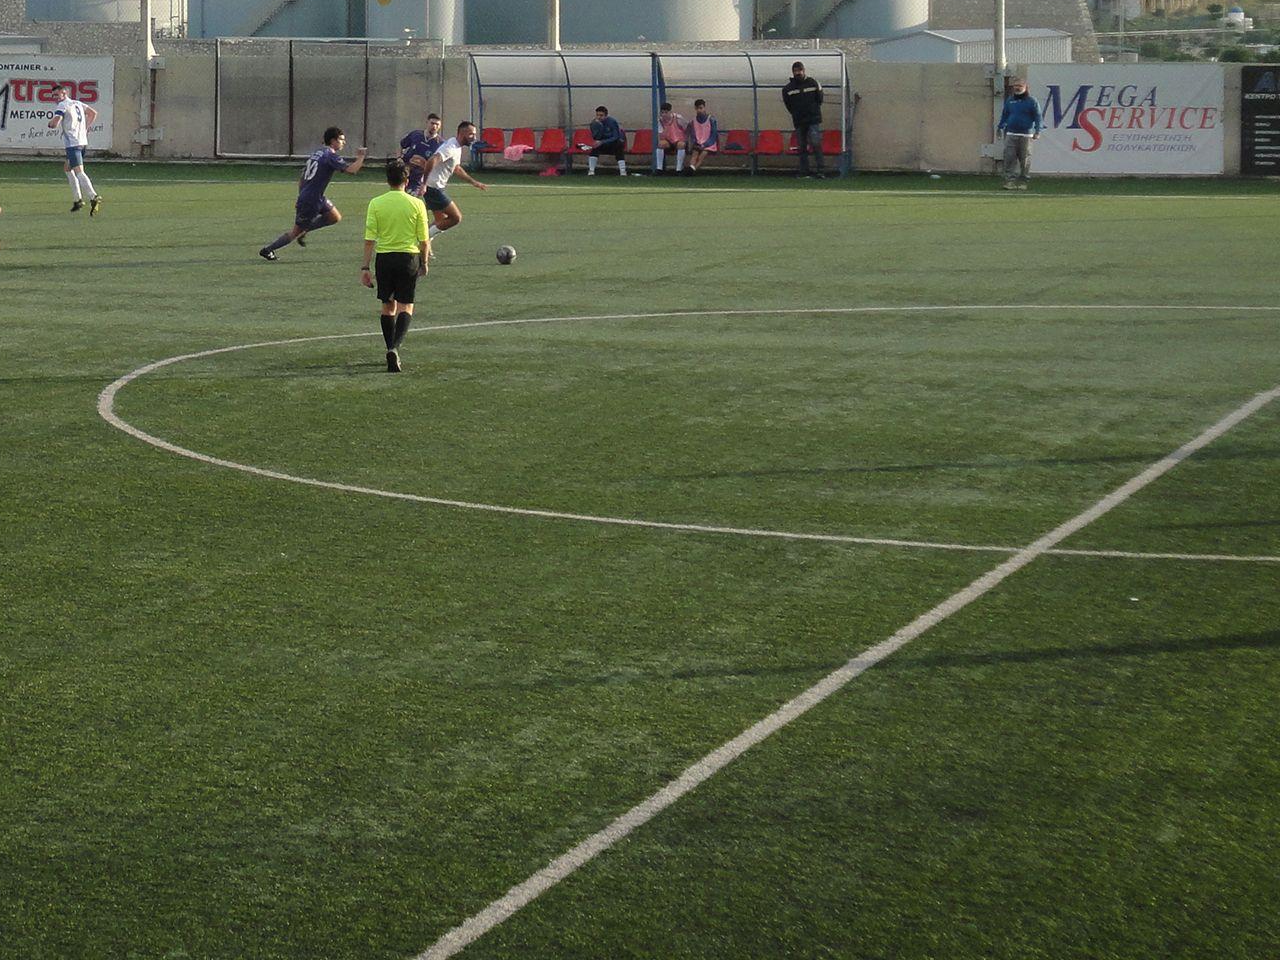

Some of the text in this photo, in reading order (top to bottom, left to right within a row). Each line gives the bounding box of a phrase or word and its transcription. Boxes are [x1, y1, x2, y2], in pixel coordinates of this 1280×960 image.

[9, 109, 54, 120] ΜΕΤΑΦΟ
[74, 105, 83, 123] 9
[1042, 84, 1158, 130] MEGA
[1071, 106, 1218, 152] SERVICE
